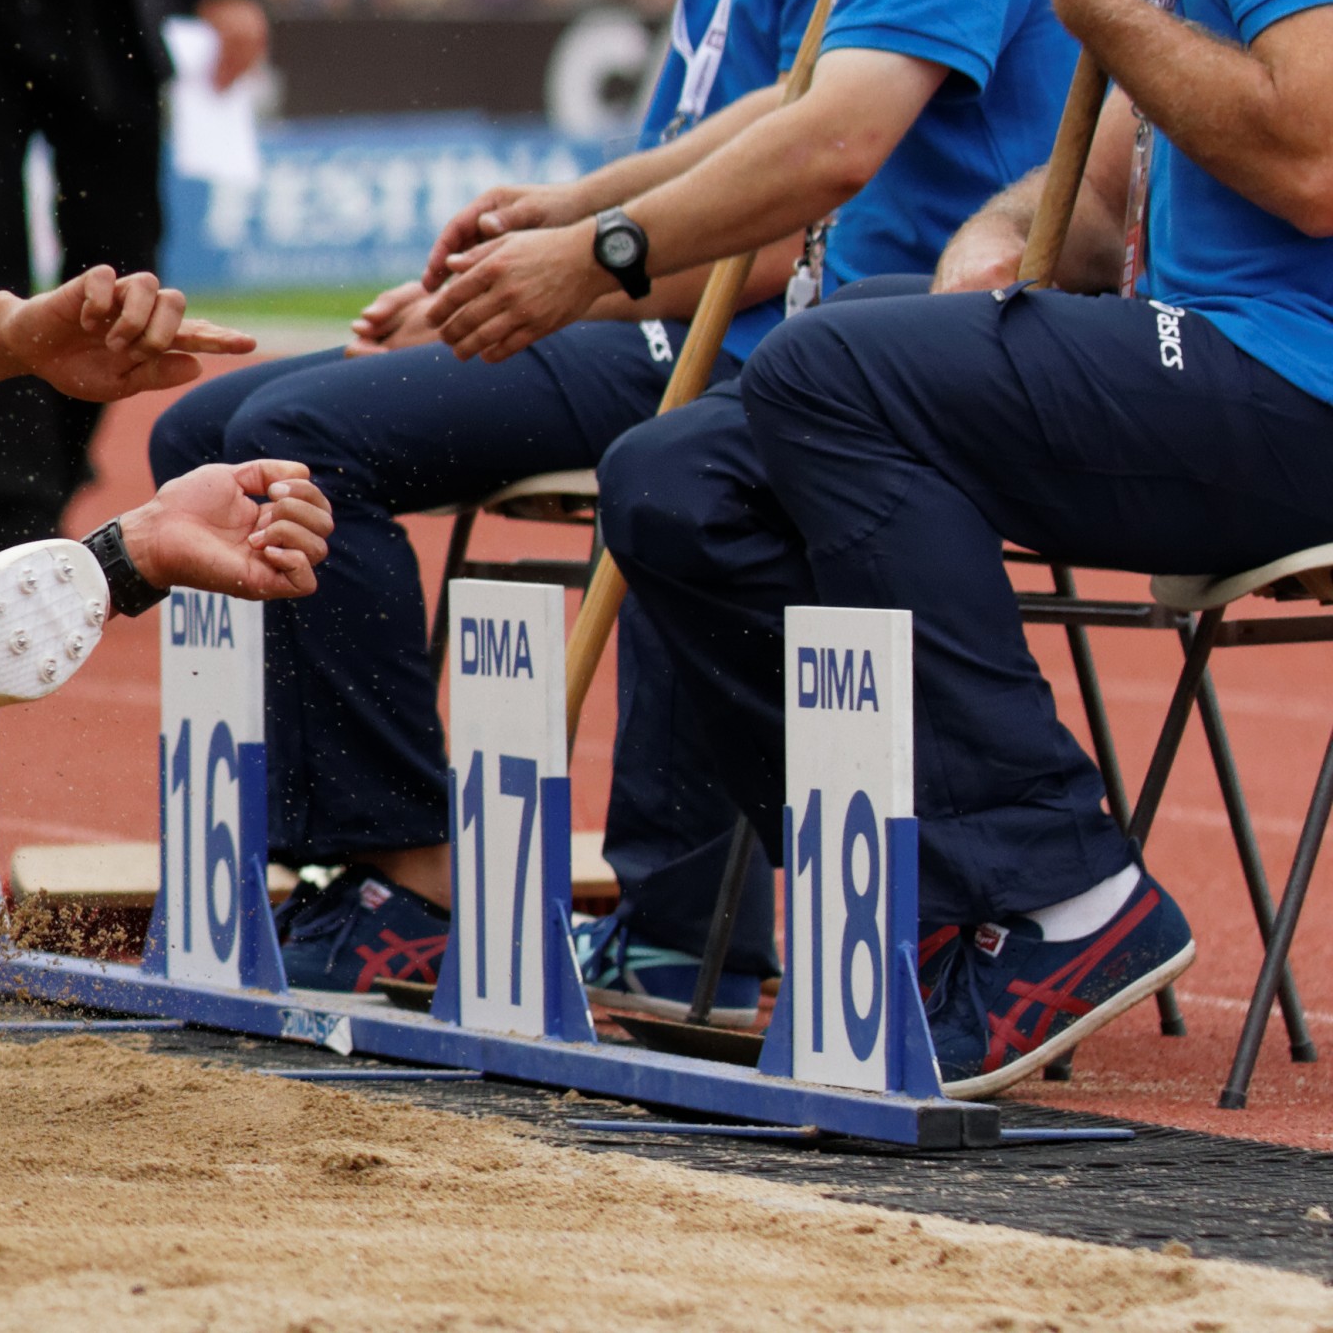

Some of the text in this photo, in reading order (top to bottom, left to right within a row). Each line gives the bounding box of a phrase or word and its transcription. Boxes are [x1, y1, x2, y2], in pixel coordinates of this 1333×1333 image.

[1156, 312, 1184, 370] asics
[171, 592, 235, 648] DIMA
[460, 617, 534, 679] DIMA
[797, 646, 880, 713] DIMA
[164, 718, 242, 964] 16
[462, 749, 538, 1007] 17
[797, 788, 884, 1063] 18
